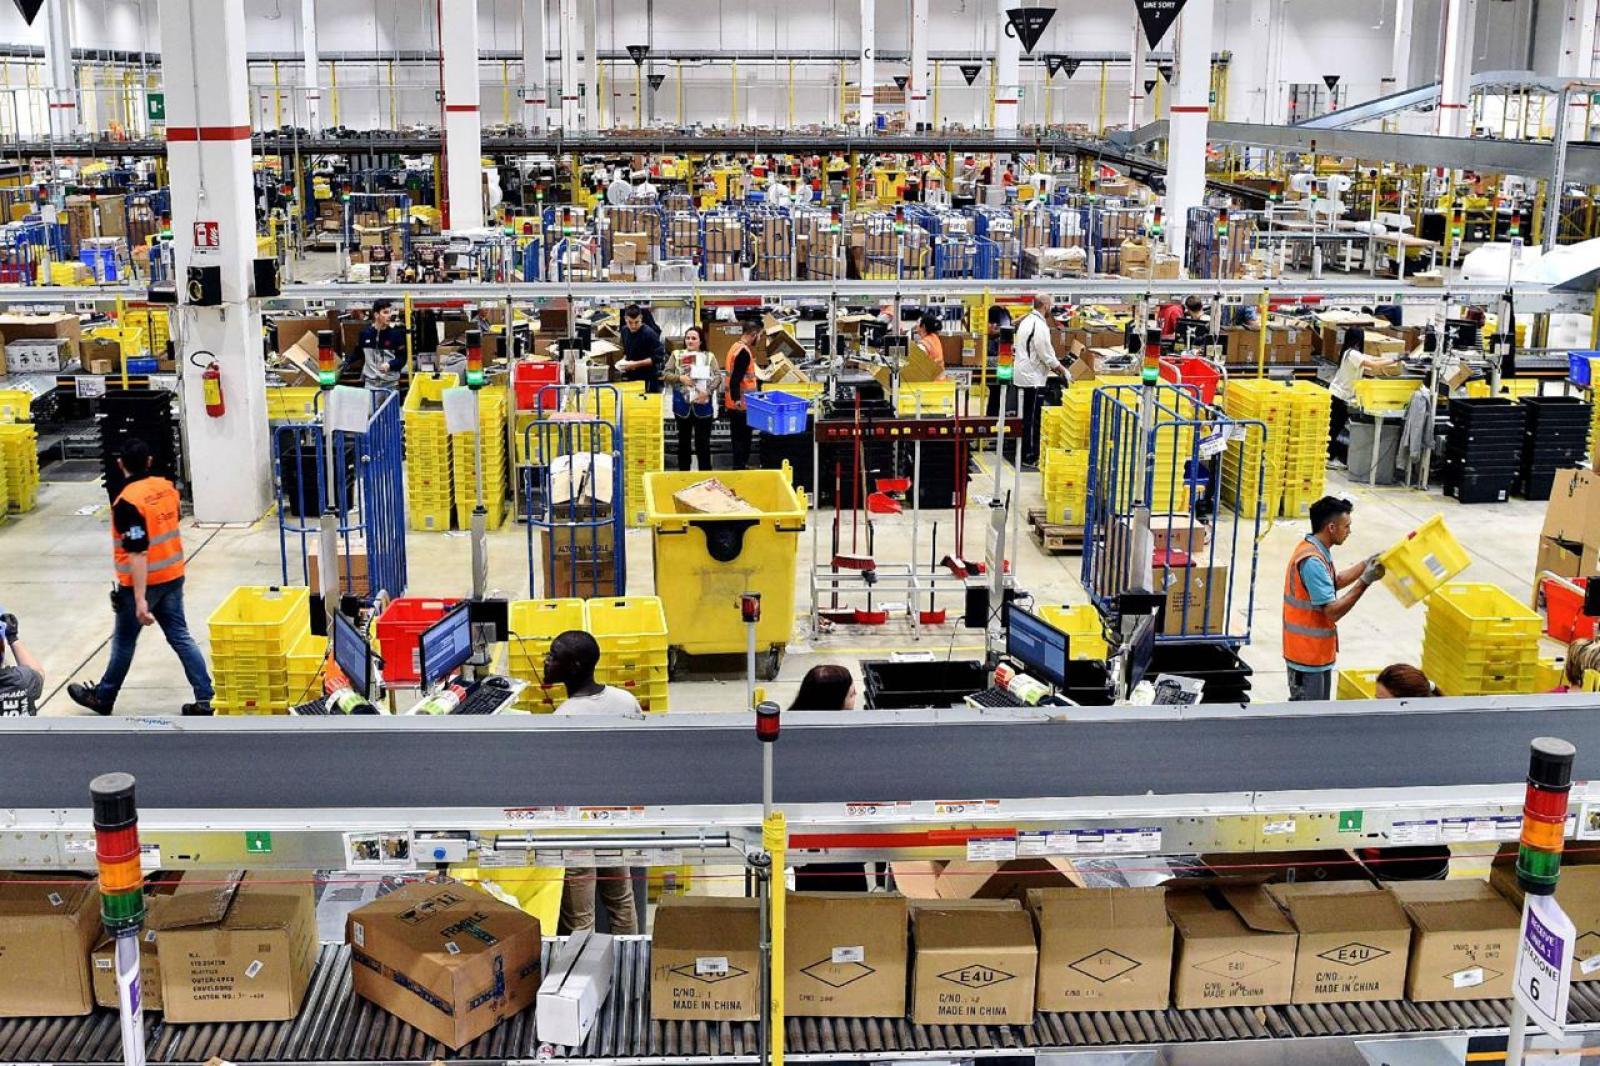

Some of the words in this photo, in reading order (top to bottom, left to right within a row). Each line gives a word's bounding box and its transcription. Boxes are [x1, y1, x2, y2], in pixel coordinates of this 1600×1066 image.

[1338, 949, 1369, 960] E4U
[960, 971, 993, 982] E4U
[1315, 984, 1339, 993] MADE
[1342, 984, 1351, 992] IN
[1354, 981, 1380, 992] CHINA
[1530, 976, 1540, 1001] 6
[673, 1000, 698, 1009] MADE
[702, 1001, 711, 1010] IN
[715, 1001, 742, 1010] CHINA
[938, 1005, 963, 1015] MADE
[966, 1006, 976, 1015] IN
[979, 1006, 1007, 1016] CHINA
